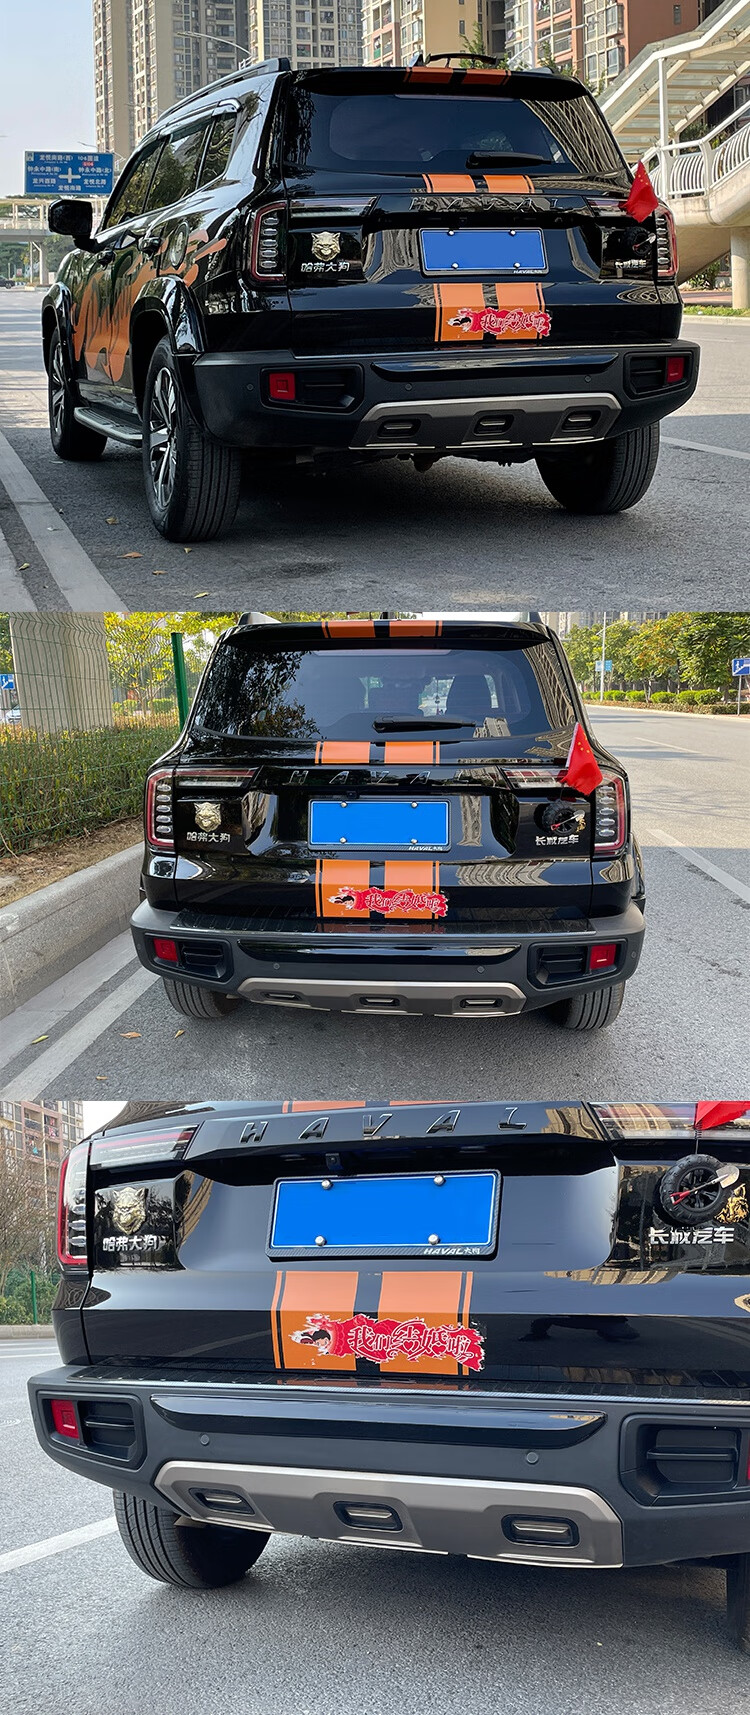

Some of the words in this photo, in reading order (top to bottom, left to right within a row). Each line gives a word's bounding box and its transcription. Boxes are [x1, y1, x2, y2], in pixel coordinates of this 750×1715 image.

[301, 262, 350, 272] 哈弗大狗
[289, 770, 470, 784] HAVAL
[186, 831, 231, 843] 哈弗大狗
[535, 834, 579, 846] 长城汽车
[364, 889, 442, 913] 我们结婚啦
[239, 1107, 528, 1144] HAVAL
[102, 1234, 158, 1252] 哈弗大狗
[648, 1226, 735, 1245] 长城汽车
[347, 1321, 475, 1362] 我们结婚啦
